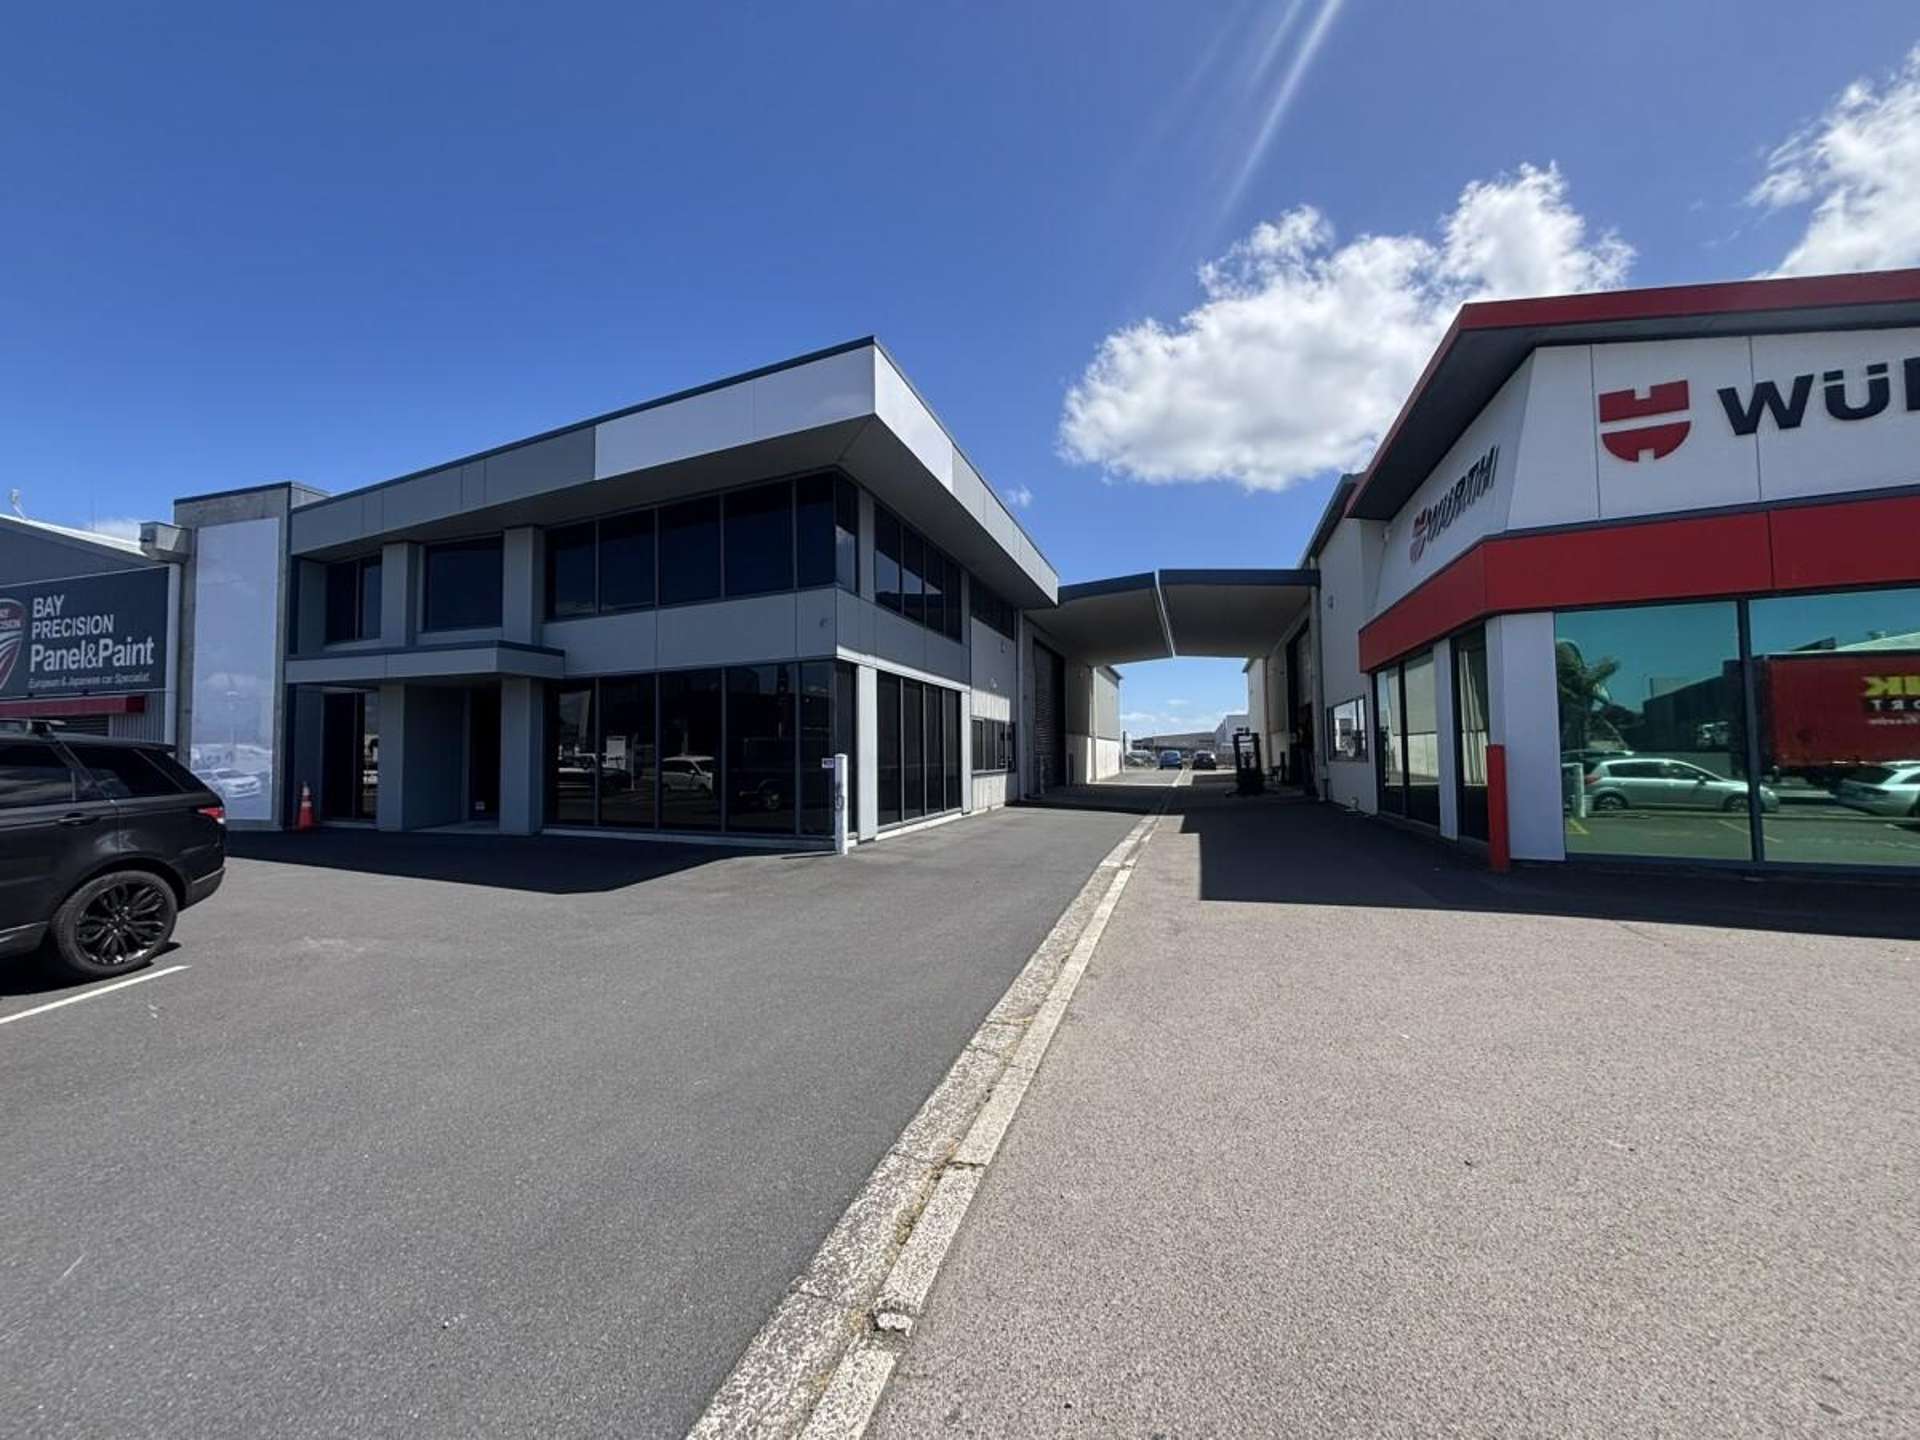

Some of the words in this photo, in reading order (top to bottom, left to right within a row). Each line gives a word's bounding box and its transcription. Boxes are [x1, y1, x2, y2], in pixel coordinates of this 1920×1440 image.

[32, 595, 65, 618] BAY
[32, 614, 114, 640] PRECISION
[29, 636, 154, 673] Panel&Paint
